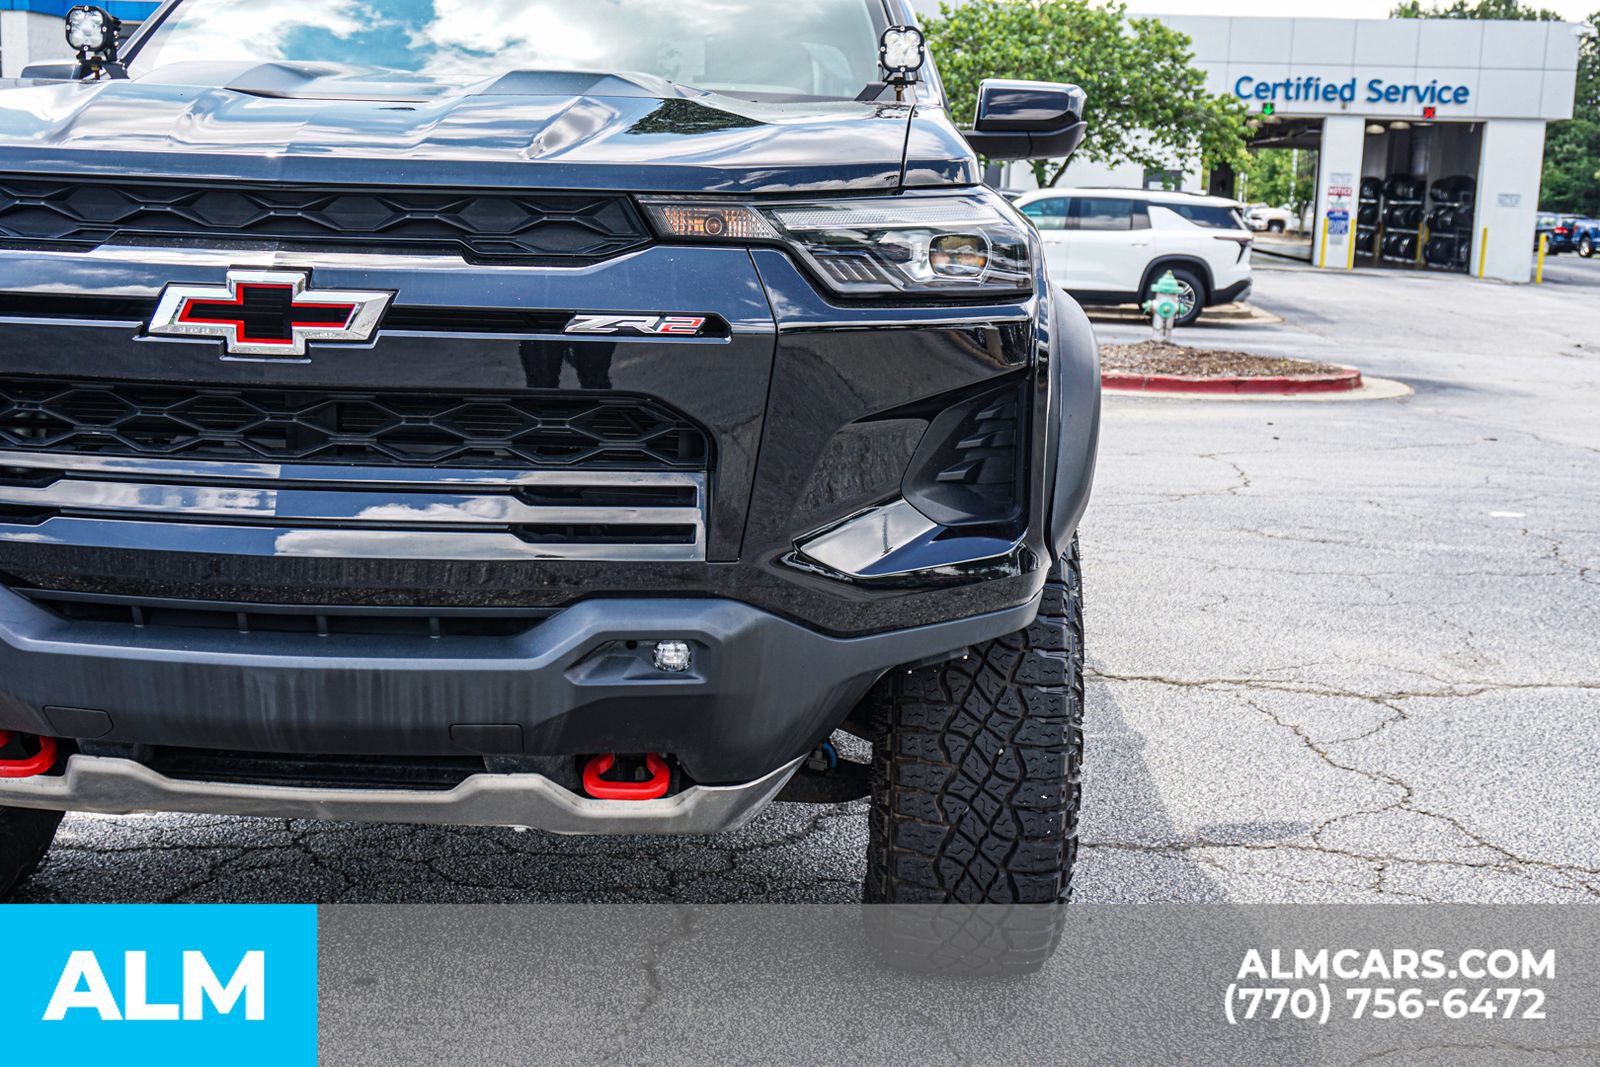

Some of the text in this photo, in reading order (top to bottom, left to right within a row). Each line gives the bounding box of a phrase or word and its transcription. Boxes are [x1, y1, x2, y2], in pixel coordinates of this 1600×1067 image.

[1234, 75, 1470, 104] Certified Service
[564, 314, 706, 335] ZR2
